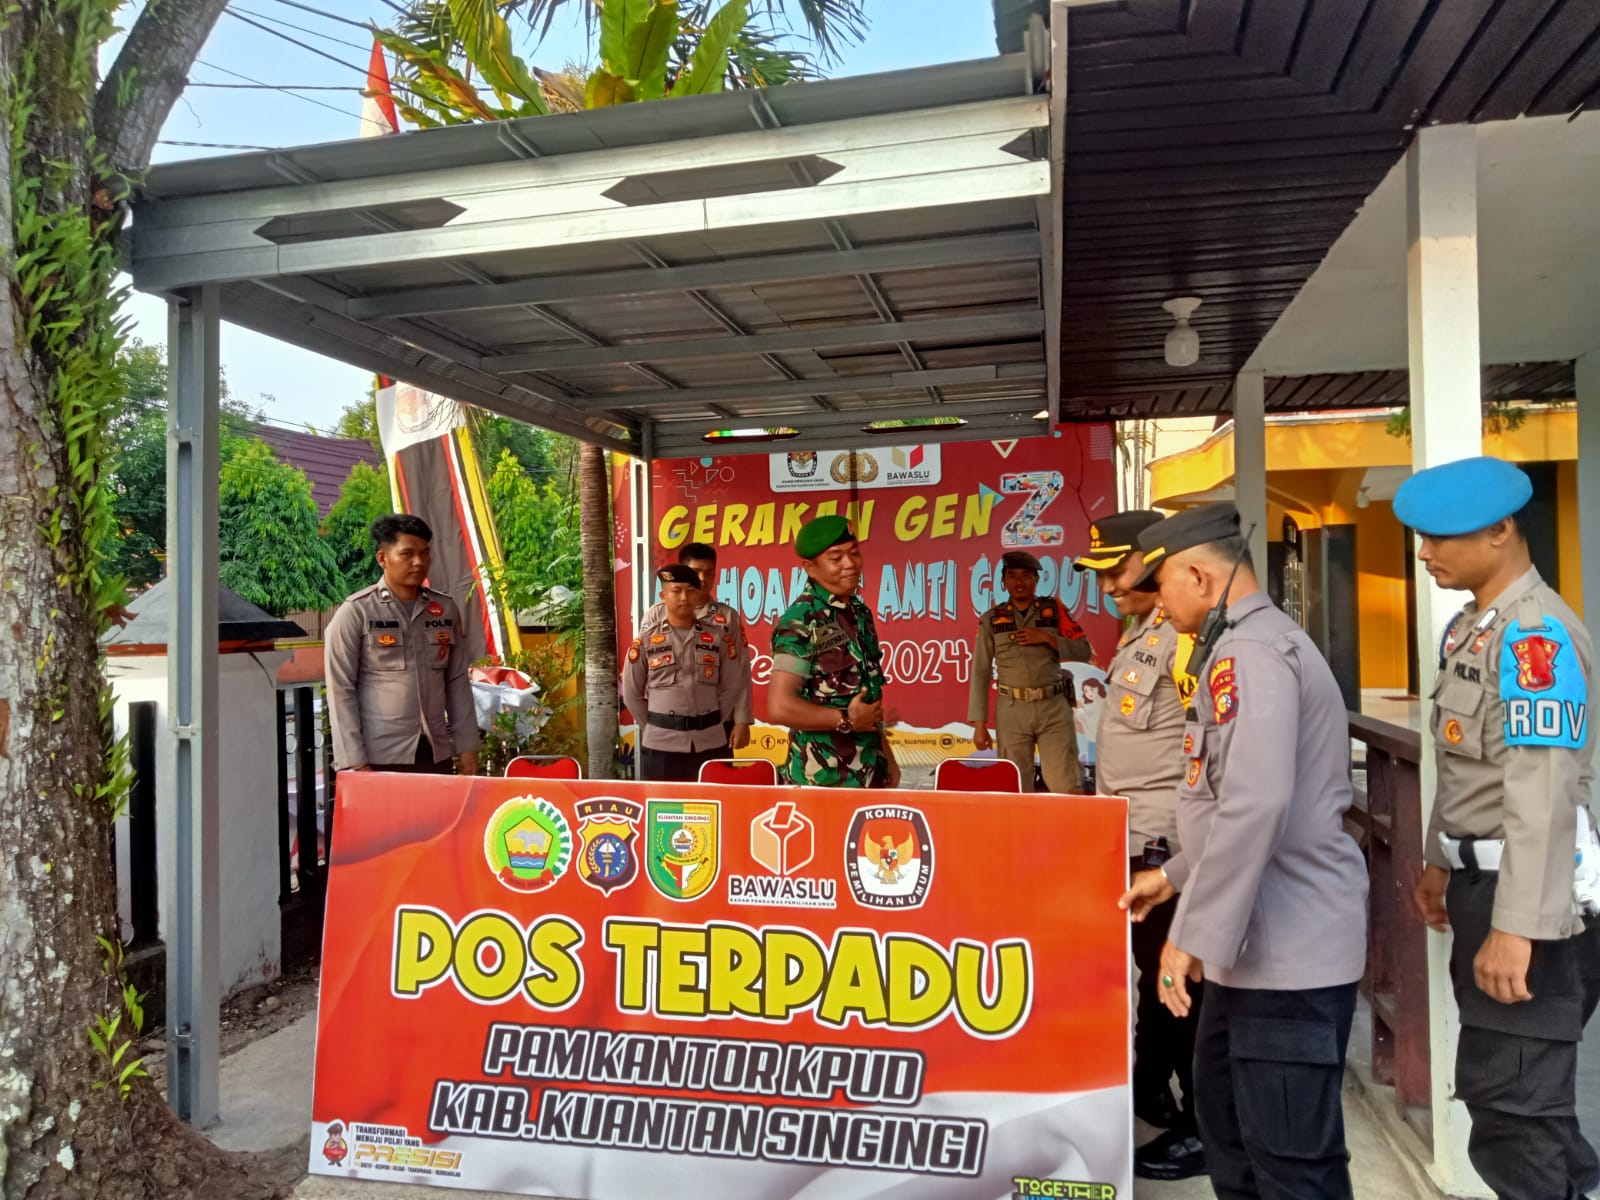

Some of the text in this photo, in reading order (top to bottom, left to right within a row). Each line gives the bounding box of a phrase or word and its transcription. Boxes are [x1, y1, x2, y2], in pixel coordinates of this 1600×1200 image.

[887, 471, 930, 480] BAWASLU
[894, 492, 996, 541] GEN
[1000, 471, 1065, 548] Z
[877, 560, 957, 623] ANTI
[425, 620, 453, 628] POLRI
[696, 643, 720, 653] POLRI
[1132, 651, 1157, 667] POLRI
[880, 639, 972, 684] 2024
[585, 804, 634, 815] RIAU
[865, 809, 914, 821] KOMISI
[730, 877, 835, 900] BAWASLU
[849, 862, 930, 905] PEMILIHAN UMUM
[393, 907, 1030, 1037] POS TERPADU
[484, 1025, 923, 1103] PAM KANTOR KPUD
[355, 1125, 406, 1137] TRANSFORMASI
[355, 1134, 420, 1147] MENUJU POLRI YANG
[430, 1083, 986, 1175] KAB. KUANTAN SINGINGI
[354, 1143, 463, 1169] PRESISI
[1013, 1177, 1115, 1200] TOGETHER
